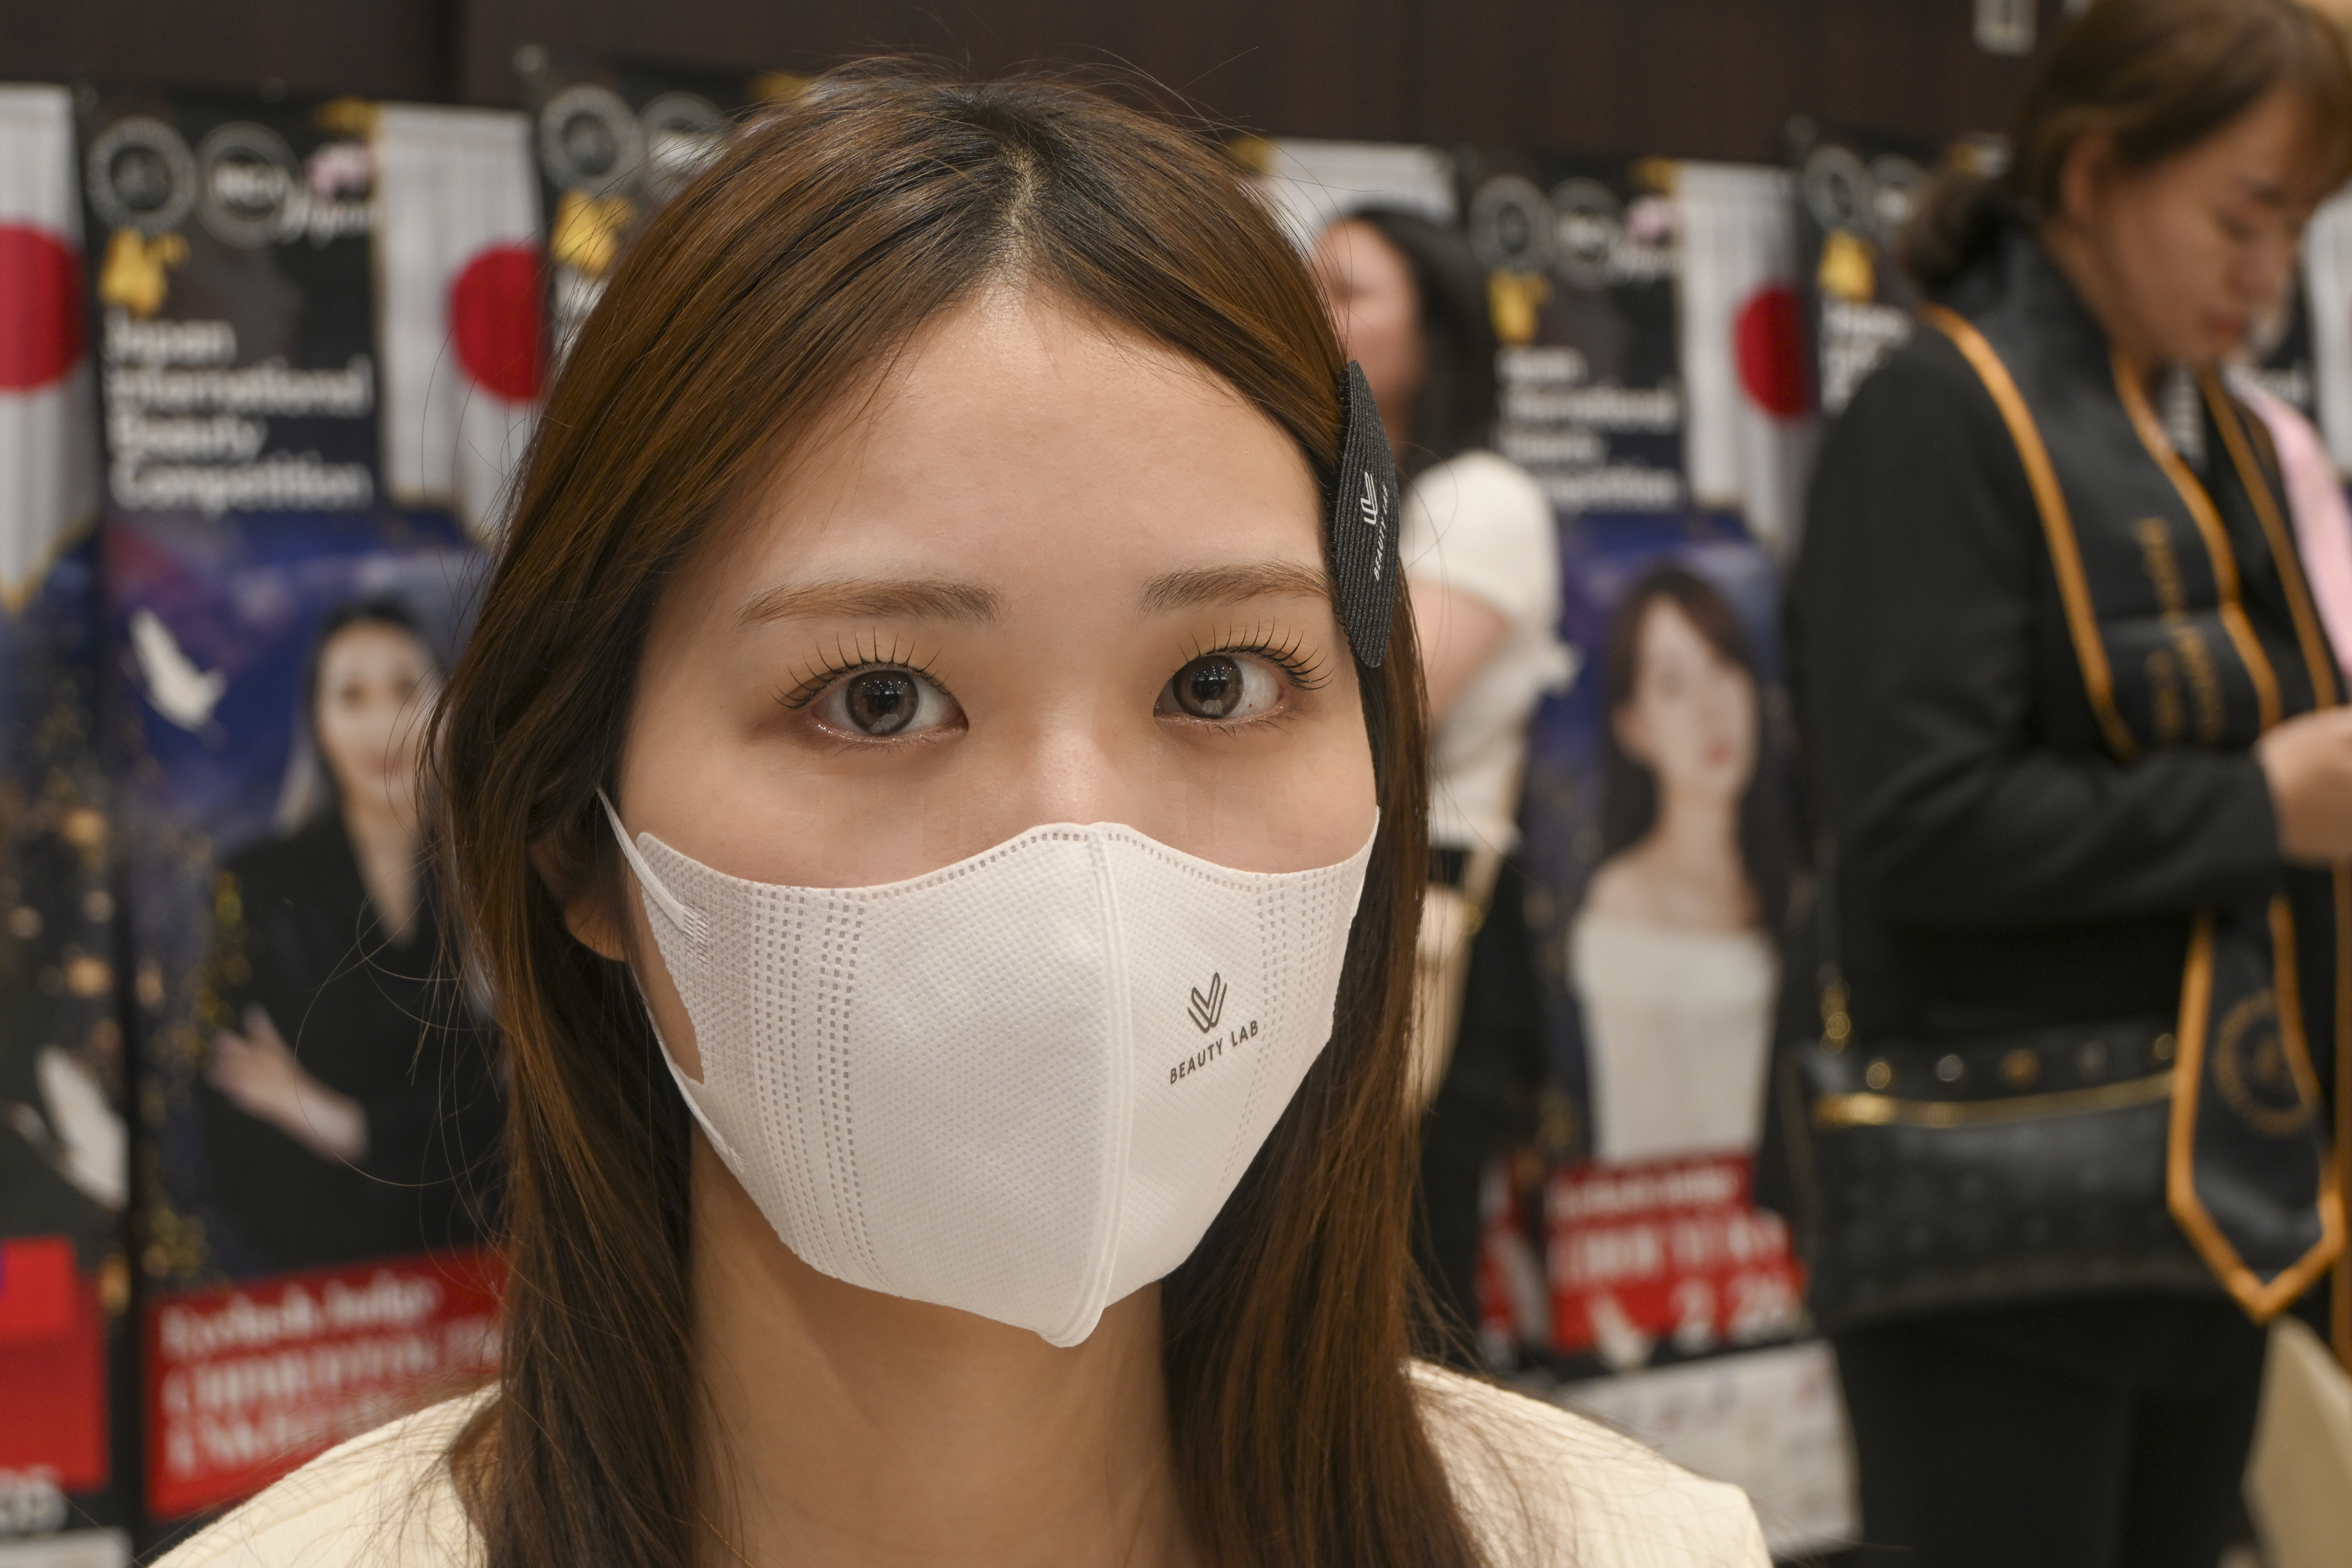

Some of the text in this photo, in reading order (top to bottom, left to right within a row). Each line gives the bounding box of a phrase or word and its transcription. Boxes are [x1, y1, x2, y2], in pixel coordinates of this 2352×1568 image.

[1374, 515, 1386, 581] BEAUTY
[1170, 1020, 1258, 1084] BEAUTY LAB
